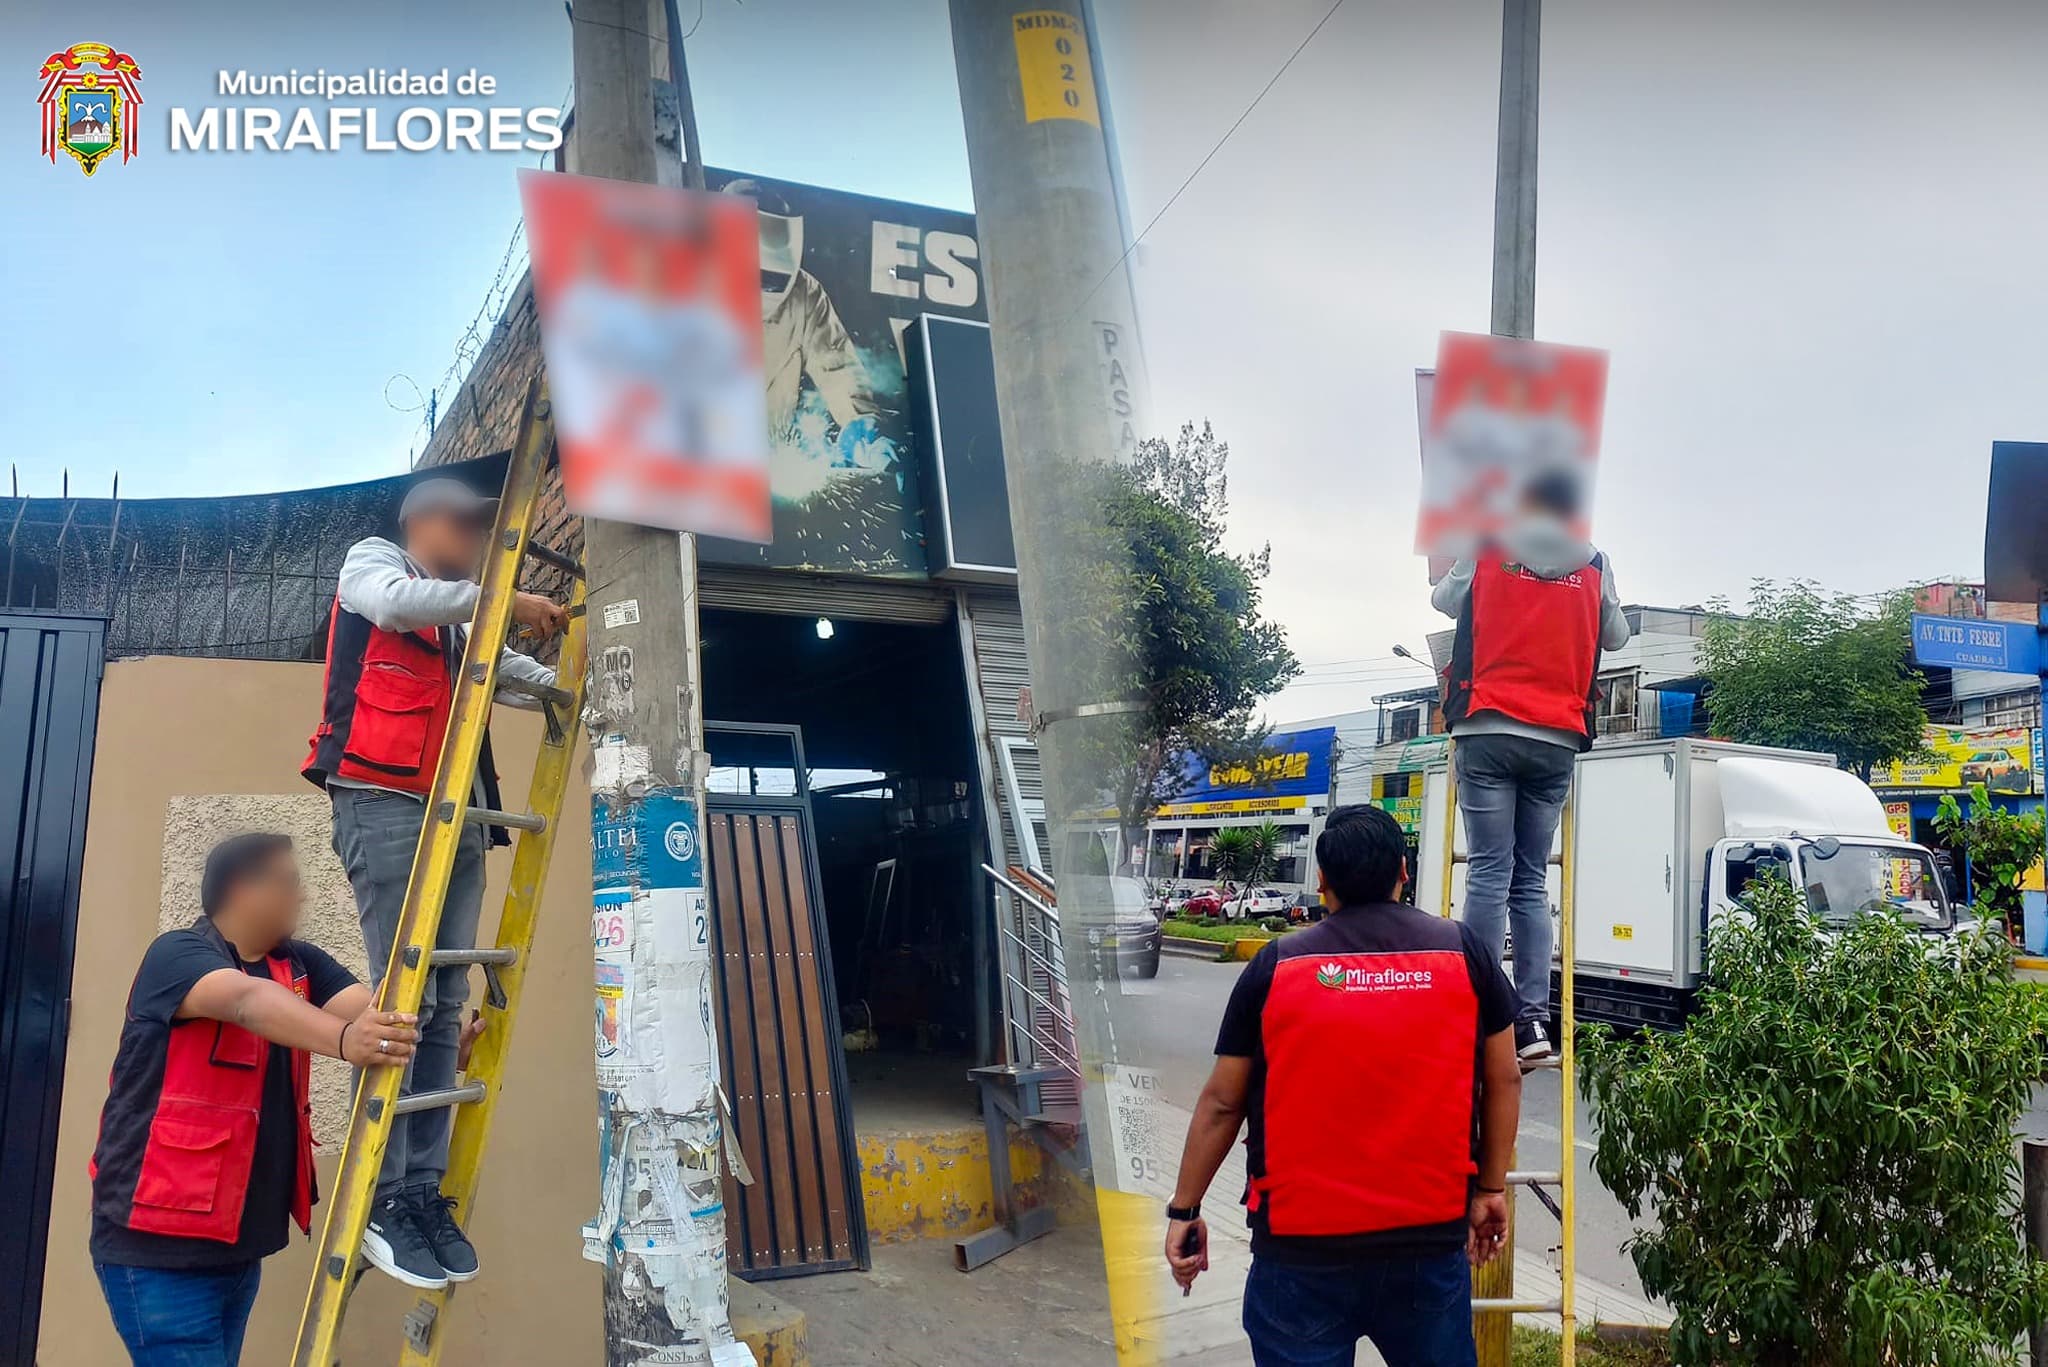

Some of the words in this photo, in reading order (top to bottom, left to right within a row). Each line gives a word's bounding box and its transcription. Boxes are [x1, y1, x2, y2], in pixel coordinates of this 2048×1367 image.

[870, 220, 979, 308] ES
[1920, 624, 1935, 641] AV.
[1969, 629, 2003, 648] FERRE
[1956, 652, 1995, 664] CUADRA
[1887, 803, 1908, 814] GPS
[1346, 968, 1432, 985] Miraflores
